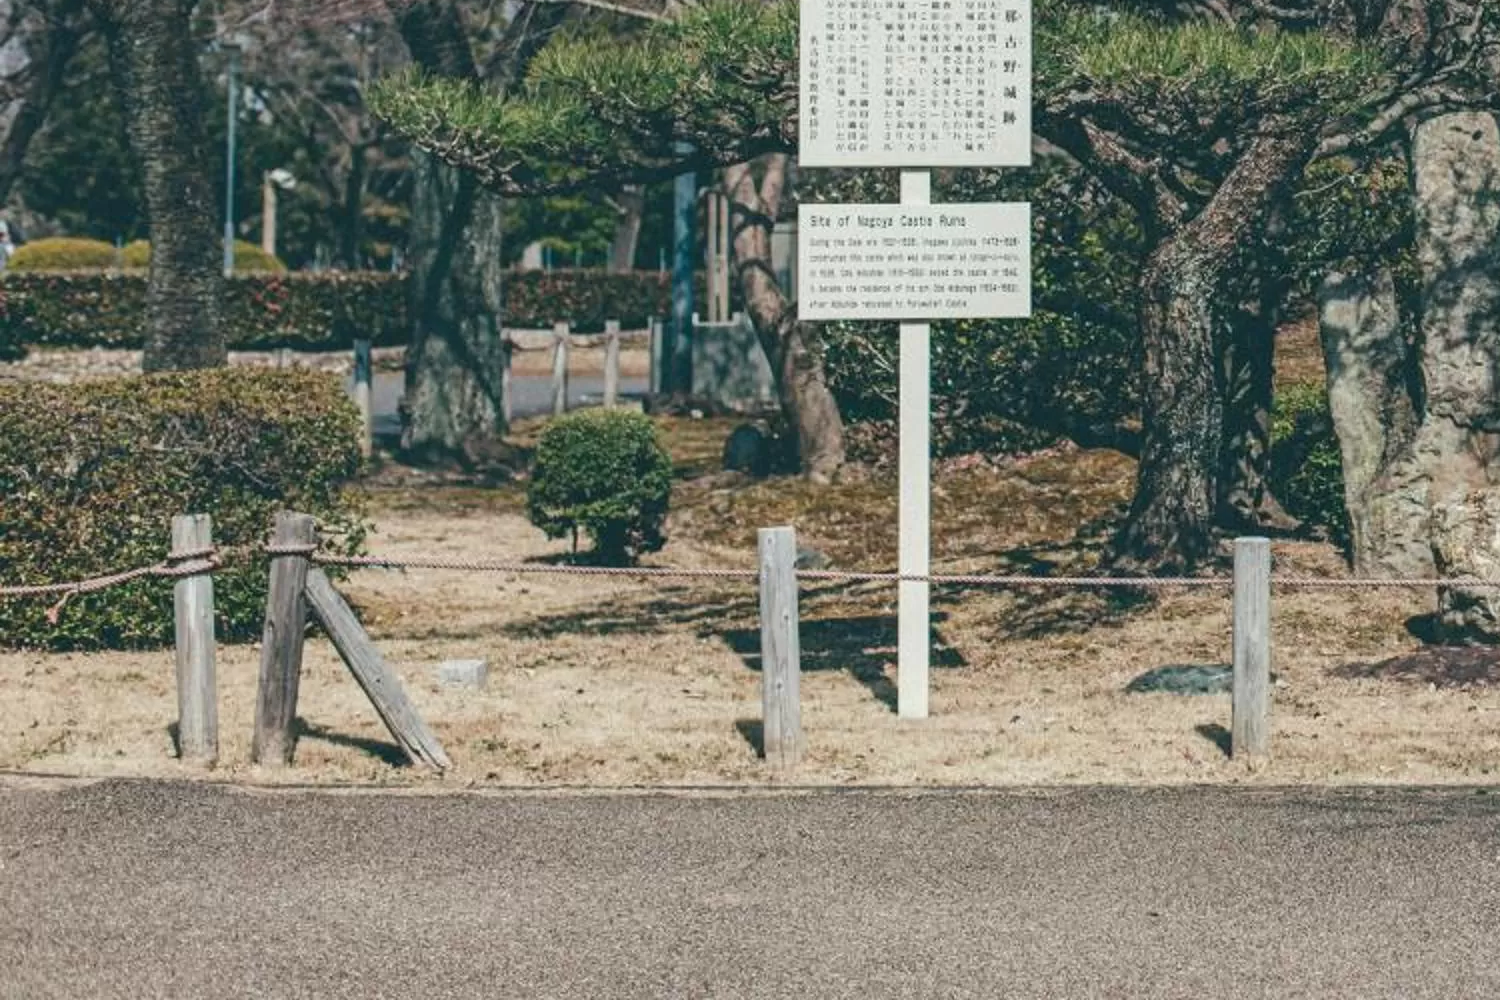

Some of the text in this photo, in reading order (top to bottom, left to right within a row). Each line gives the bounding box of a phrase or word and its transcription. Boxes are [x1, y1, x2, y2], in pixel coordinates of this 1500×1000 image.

[810, 214, 966, 229] Site of Nagoya Castle Ruins
